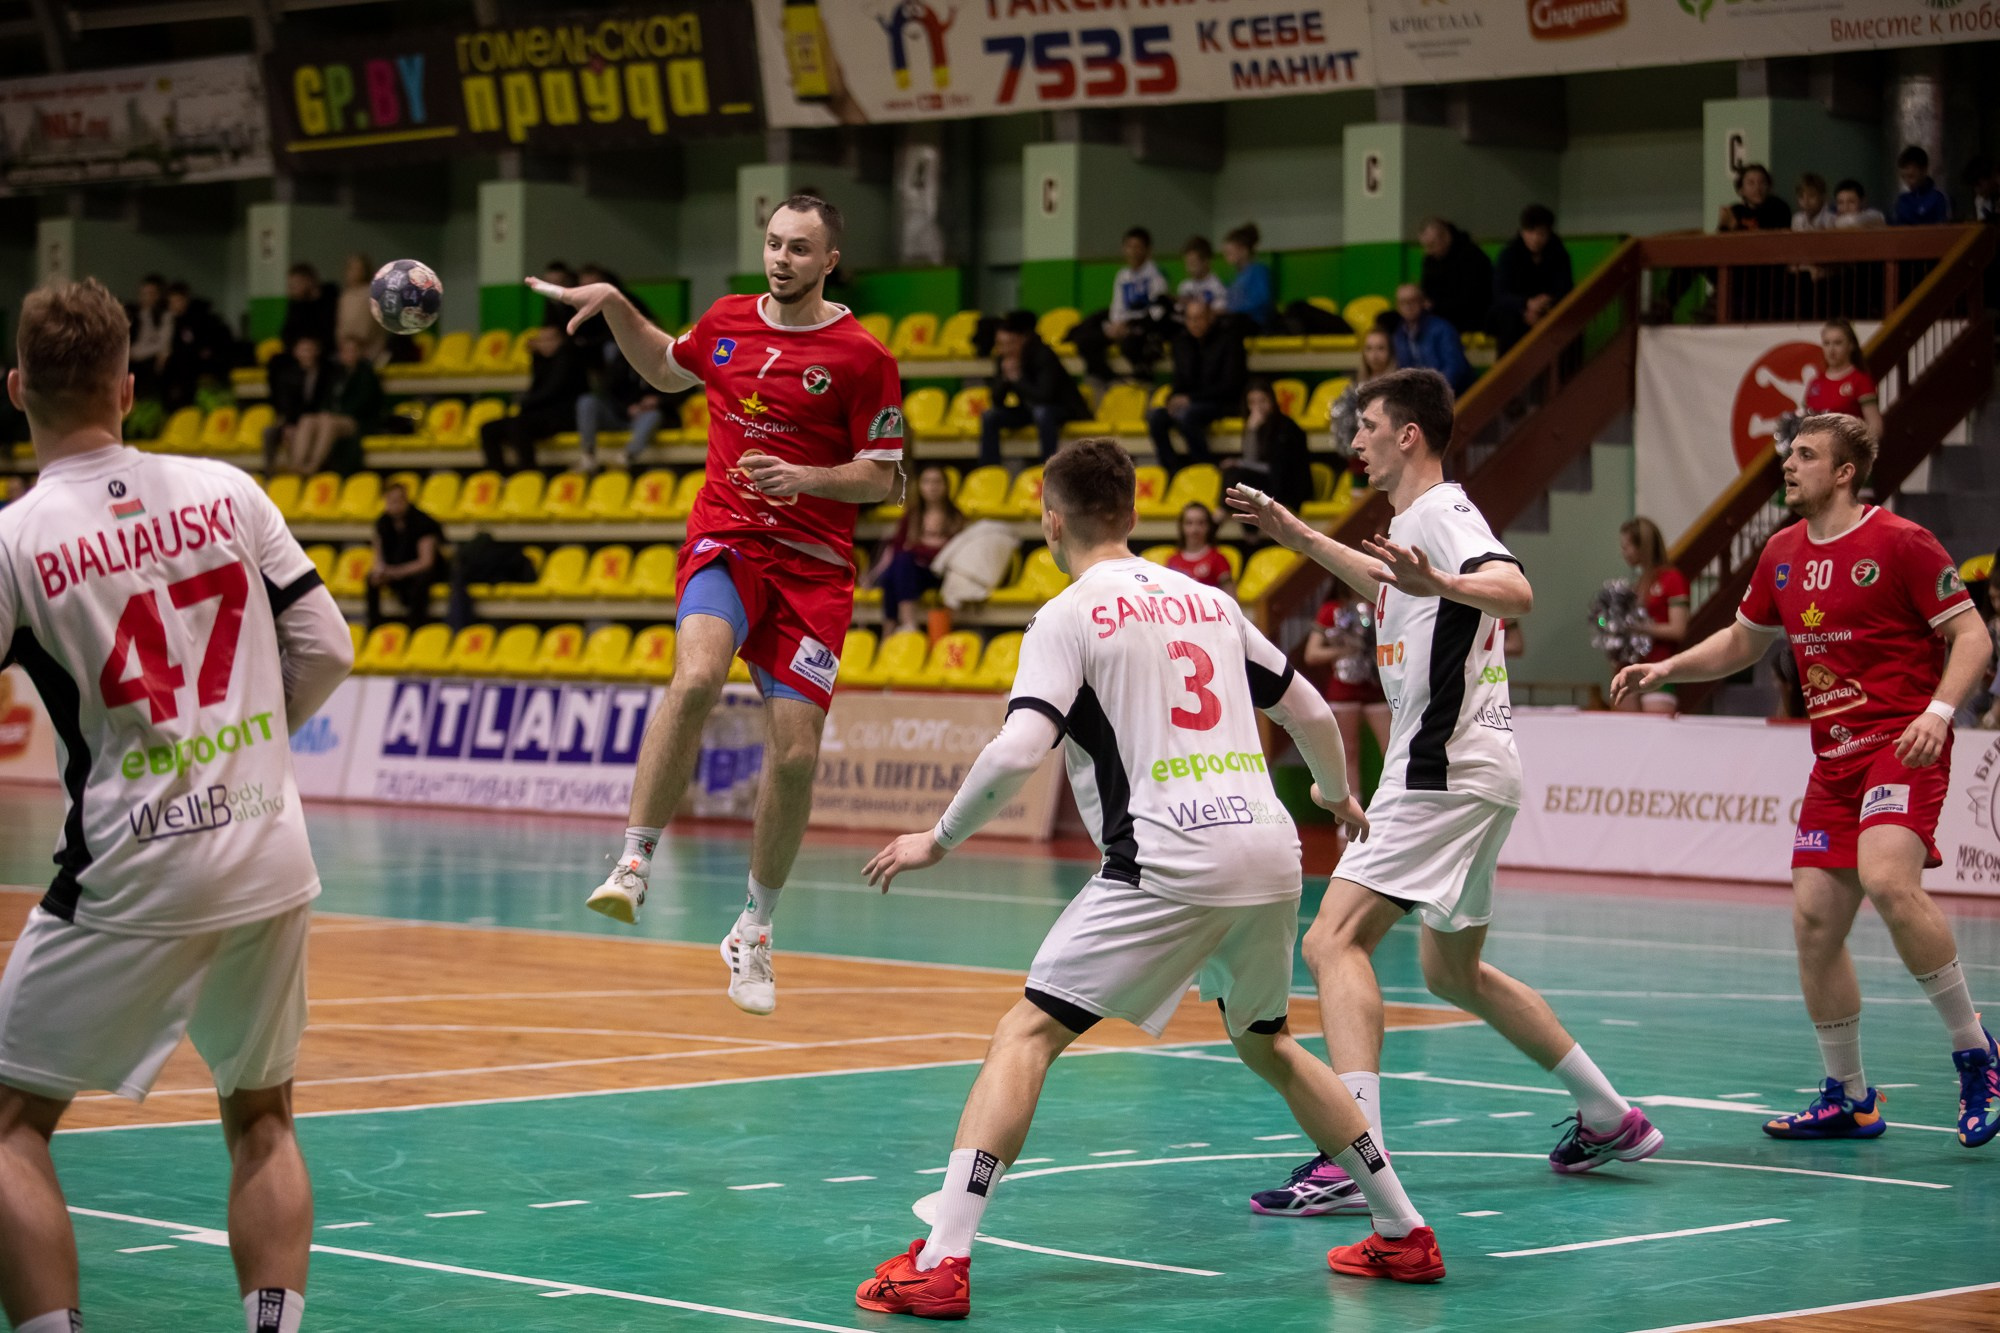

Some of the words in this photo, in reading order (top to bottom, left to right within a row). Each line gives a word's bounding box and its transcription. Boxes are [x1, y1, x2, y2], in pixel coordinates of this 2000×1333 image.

[1197, 20, 1222, 53] К
[1230, 11, 1325, 50] СЕБЕ
[1830, 15, 1921, 42] Вместе
[1929, 12, 1944, 34] к
[983, 25, 1178, 105] 7535
[1231, 51, 1358, 90] МАНИТ
[292, 53, 427, 136] GP.BY
[757, 346, 783, 380] 7
[35, 498, 237, 600] BIALIAUSKI
[1802, 558, 1834, 592] 30
[1091, 593, 1232, 640] SAMOILA
[1790, 629, 1853, 645] ОМЕЛЬСКИЙ
[99, 561, 248, 725] 47
[1804, 643, 1828, 657] ДСК
[1166, 640, 1222, 732] 3
[387, 682, 650, 758] ATLANT
[1544, 784, 1780, 825] БЕЛОВЕЖСКИЕ
